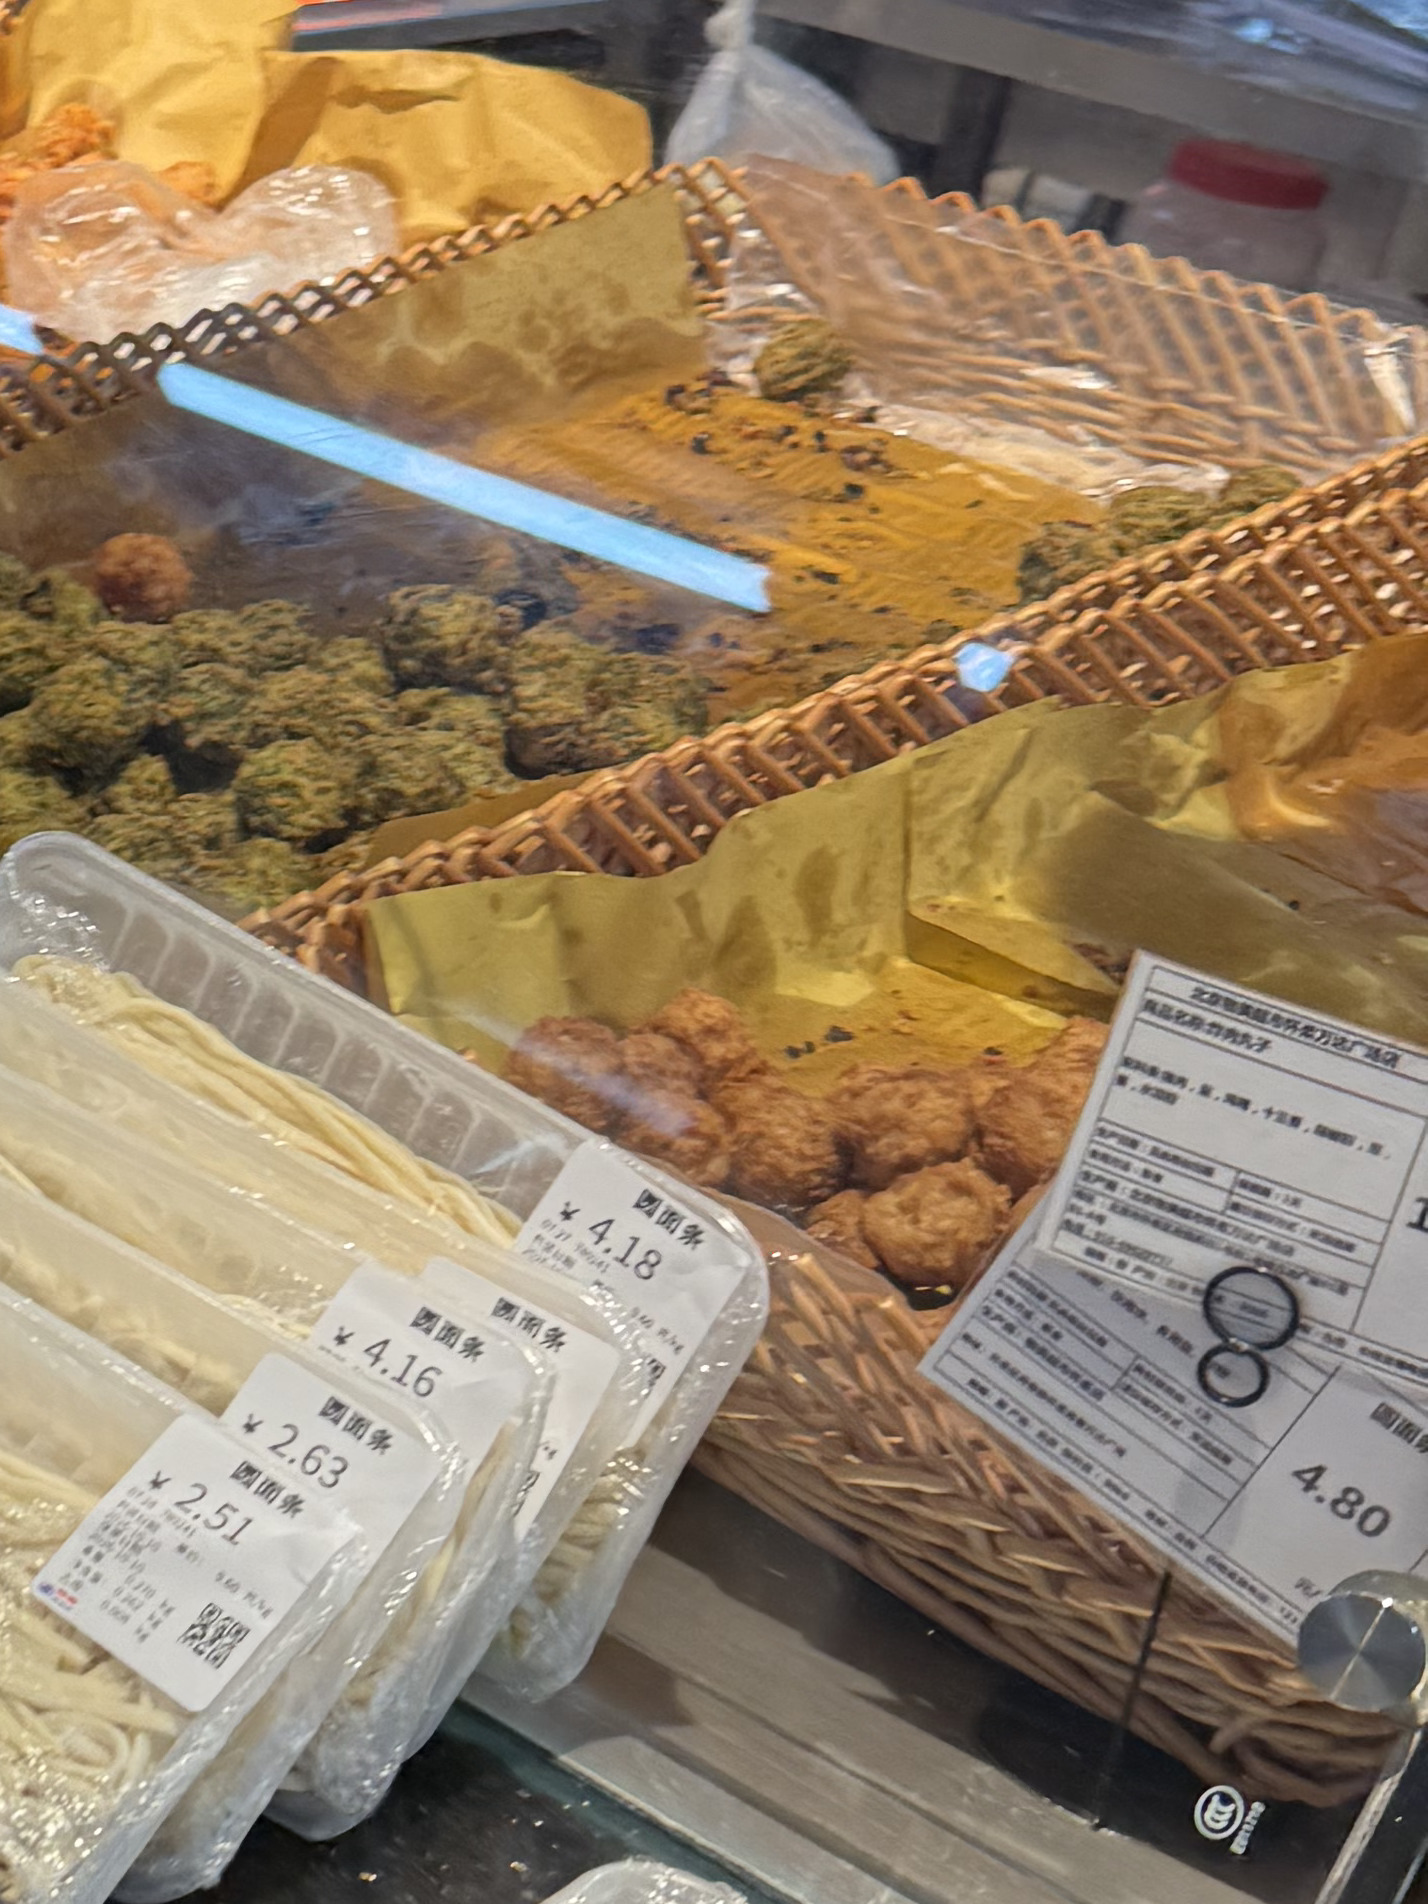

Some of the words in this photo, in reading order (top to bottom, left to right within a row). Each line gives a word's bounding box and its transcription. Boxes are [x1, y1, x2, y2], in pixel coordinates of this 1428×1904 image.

[633, 1189, 704, 1249] 圆面条
[589, 1219, 661, 1280] 4.18
[410, 1307, 484, 1361] 圆面条
[492, 1298, 566, 1352] 圆面条
[364, 1339, 442, 1397] 4.16
[319, 1397, 392, 1454] 圆面条
[268, 1424, 348, 1488] 2.63
[174, 1483, 252, 1545] 2.51
[230, 1461, 304, 1517] 圆面条
[1292, 1465, 1390, 1537] 4.80
